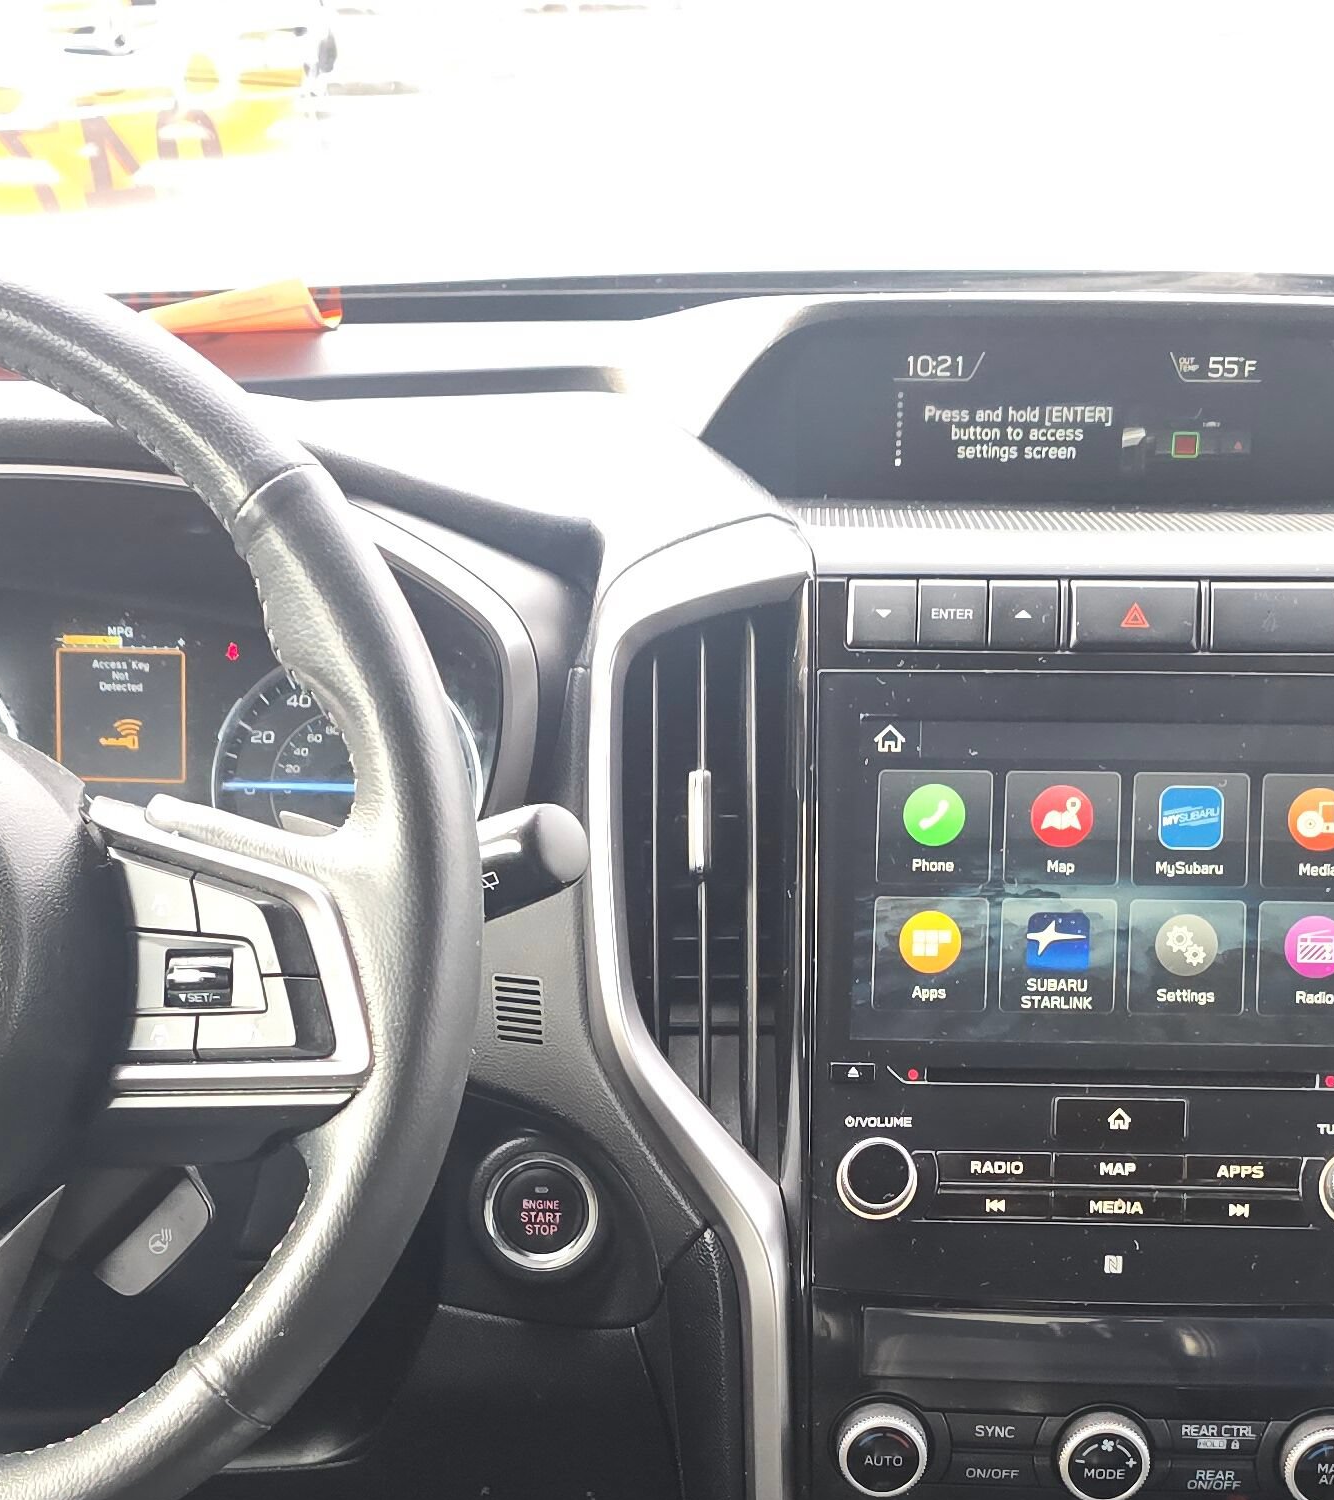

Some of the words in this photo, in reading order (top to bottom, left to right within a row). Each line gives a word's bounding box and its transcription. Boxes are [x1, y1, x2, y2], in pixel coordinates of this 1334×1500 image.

[907, 355, 963, 377] 10:21
[924, 405, 969, 422] Press
[975, 406, 1002, 422] and
[1008, 406, 1040, 422] hold
[1045, 406, 1113, 427] [ENTER]
[951, 425, 1000, 441] button
[1007, 426, 1024, 441] to
[1029, 428, 1084, 441] access
[957, 443, 1018, 462] settings
[1024, 446, 1077, 459] screen
[931, 607, 974, 620] ENTER
[91, 659, 127, 670] Access
[132, 660, 150, 672] Key
[111, 671, 129, 681] Not
[98, 681, 144, 693] Detected
[286, 694, 312, 709] 40
[250, 730, 275, 744] 20
[293, 747, 309, 757] 40
[285, 764, 301, 774] 20
[911, 858, 955, 872] Phone
[1046, 860, 1075, 875] Map
[1155, 861, 1224, 877] MySubaru
[1026, 977, 1088, 992] SUBARU
[911, 985, 947, 1002] Apps
[1156, 988, 1215, 1005] Settings
[1295, 990, 1334, 1005] Radio
[1020, 995, 1093, 1010] STARLINK
[970, 1160, 1024, 1174] RADIO
[1099, 1162, 1137, 1176] MAP
[1216, 1164, 1264, 1179] APPS
[522, 1198, 560, 1210] ENGINE
[1089, 1199, 1144, 1214] MEDIA
[520, 1211, 562, 1224] START
[525, 1224, 558, 1236] STOP
[974, 1424, 1016, 1438] SYNC
[1181, 1424, 1217, 1437] REAR
[1221, 1424, 1255, 1437] CTRL
[864, 1455, 903, 1467] AUTO
[965, 1467, 1020, 1480] ON/OFF
[1083, 1468, 1126, 1480] MODE
[1196, 1470, 1235, 1480] REAR
[1187, 1480, 1242, 1491] ON/OFF
